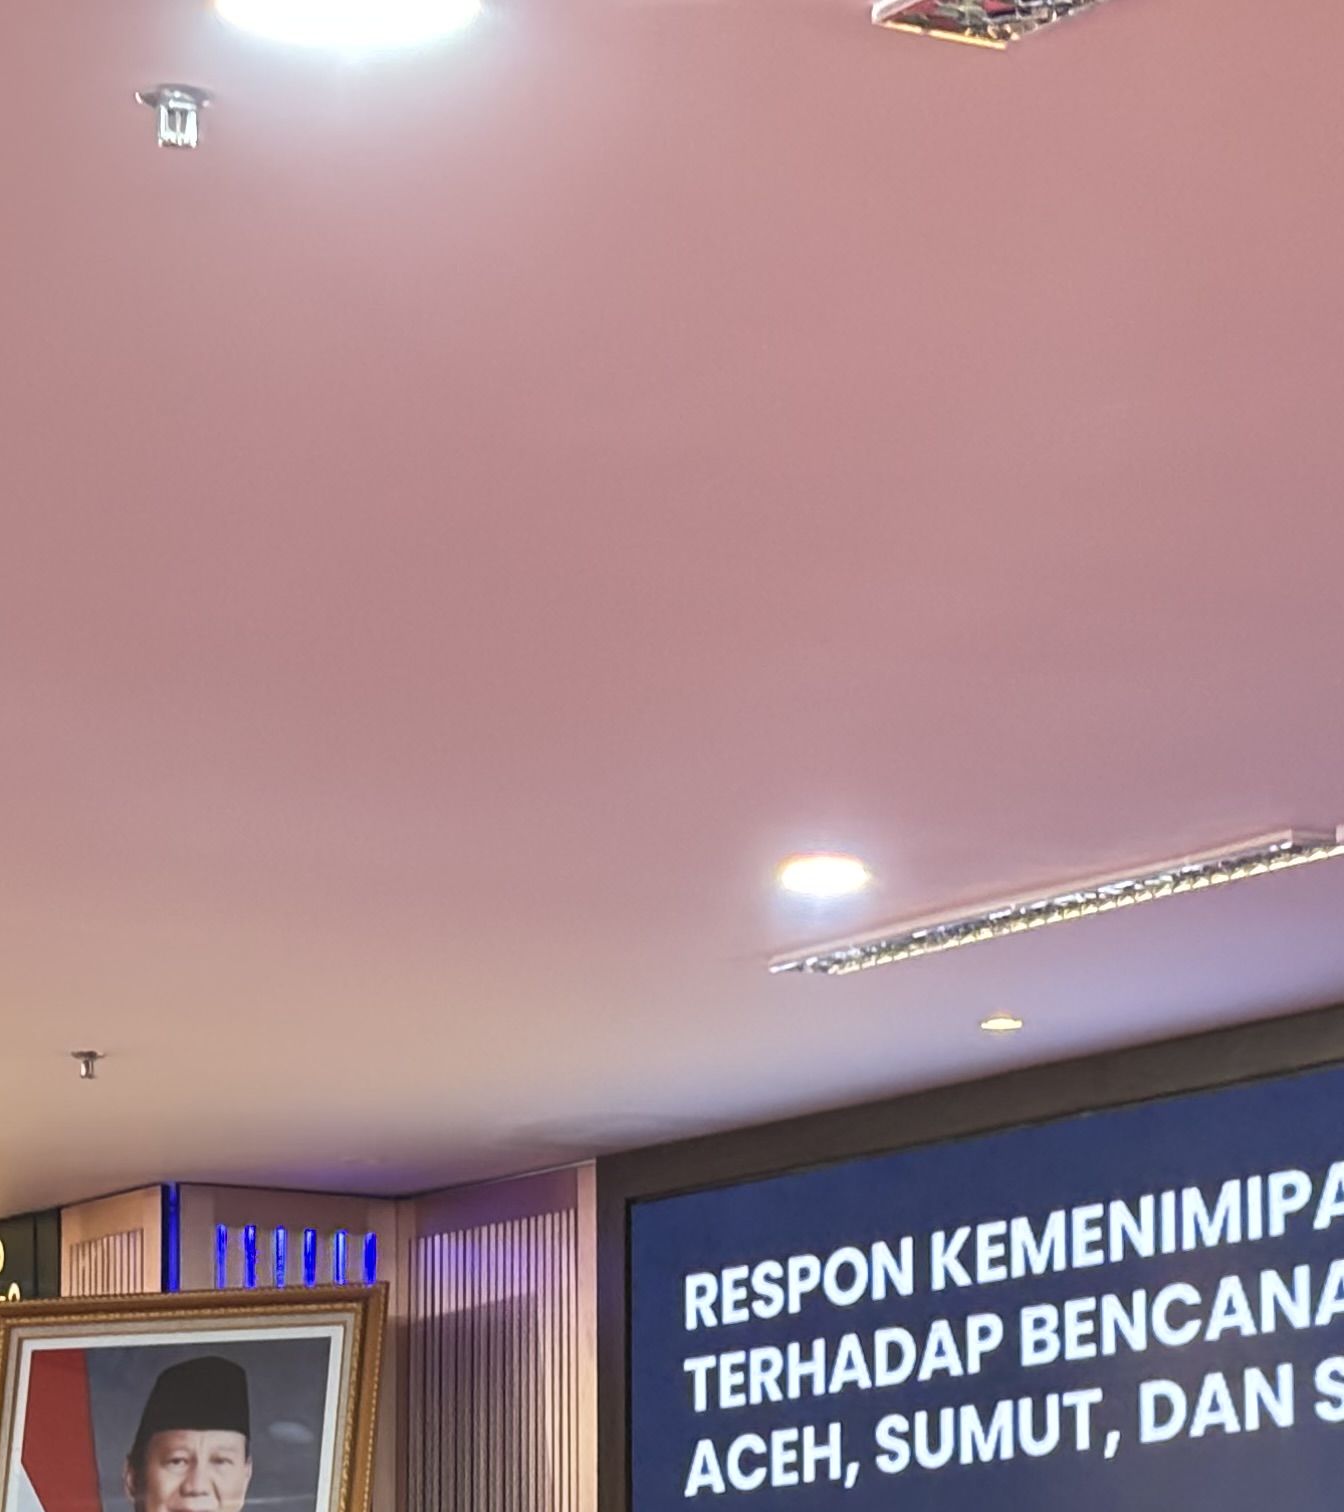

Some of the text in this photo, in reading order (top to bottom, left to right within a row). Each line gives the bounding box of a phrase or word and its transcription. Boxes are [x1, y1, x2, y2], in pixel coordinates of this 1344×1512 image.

[686, 1236, 913, 1330] RESPON
[684, 1310, 1003, 1412] TERHADAP
[685, 1422, 859, 1497] ACEH,
[876, 1388, 1120, 1473] SUMUT,
[1140, 1363, 1293, 1443] DAN
